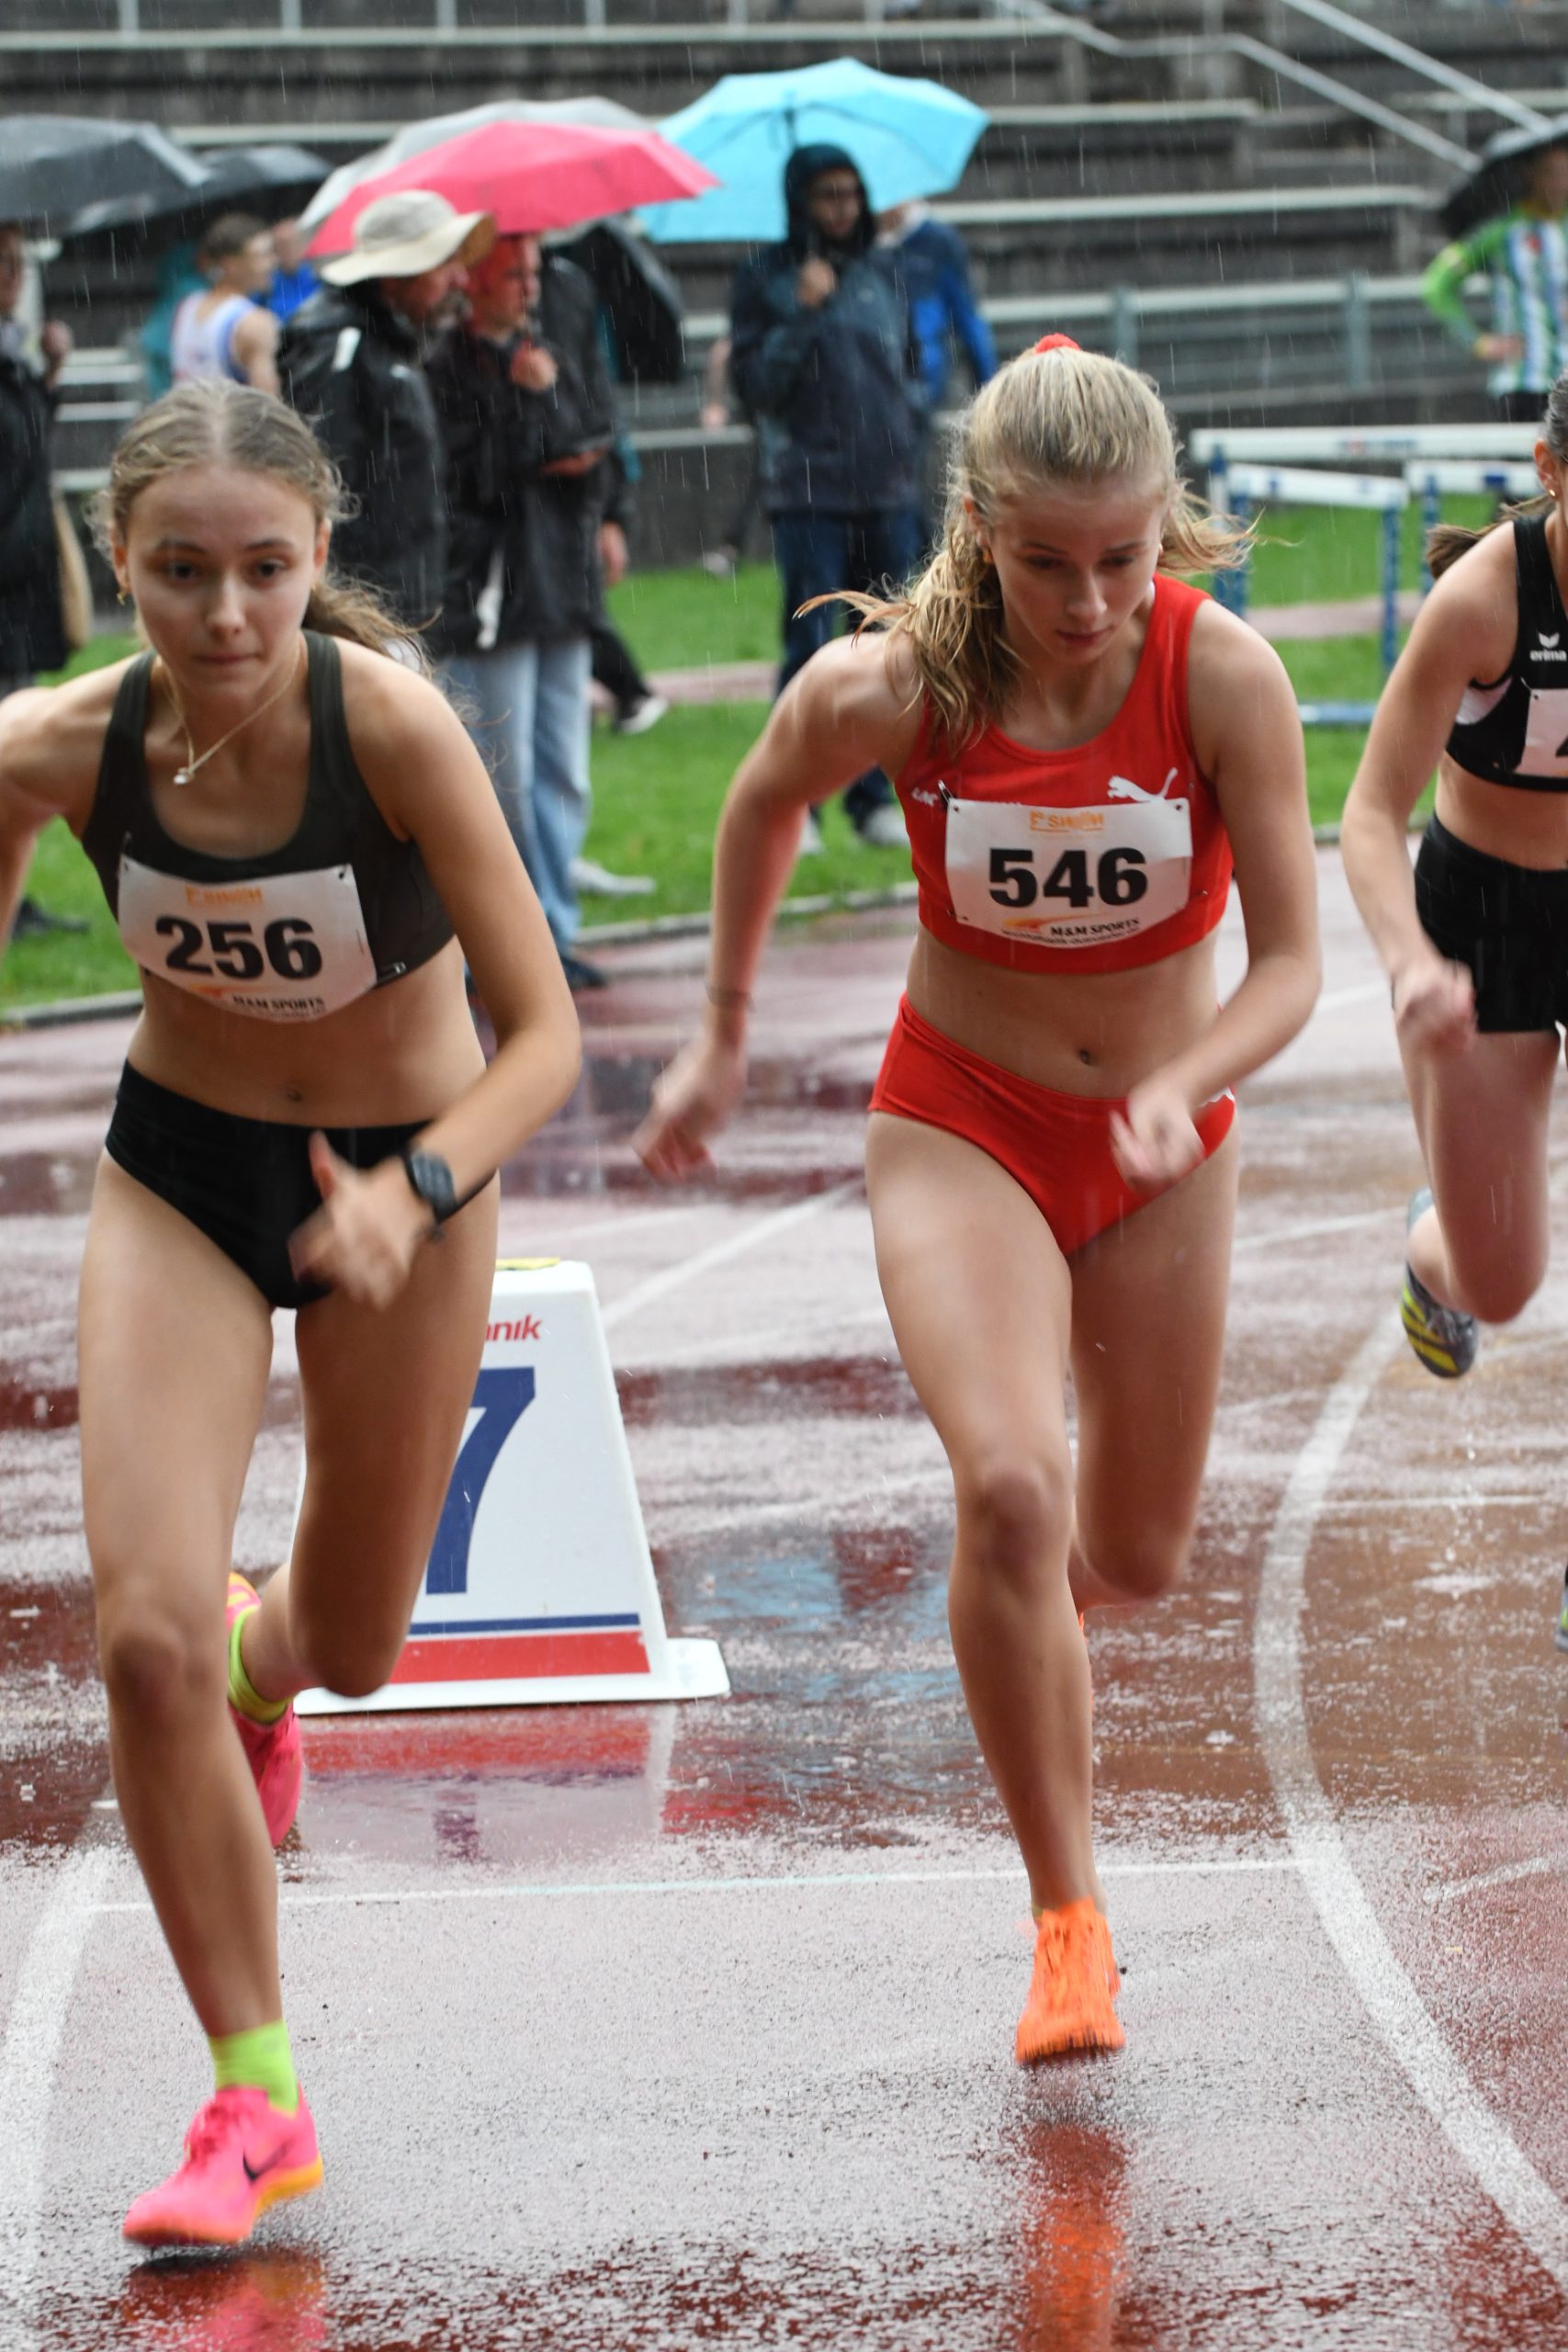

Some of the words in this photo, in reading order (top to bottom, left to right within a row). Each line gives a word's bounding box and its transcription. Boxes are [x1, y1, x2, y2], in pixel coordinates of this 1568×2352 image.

[1529, 648, 1567, 662] erima
[989, 847, 1148, 908] 546
[155, 914, 322, 980] 256
[1090, 917, 1140, 934] SPORTS
[485, 1314, 542, 1341] nik
[425, 1366, 536, 1596] 7
